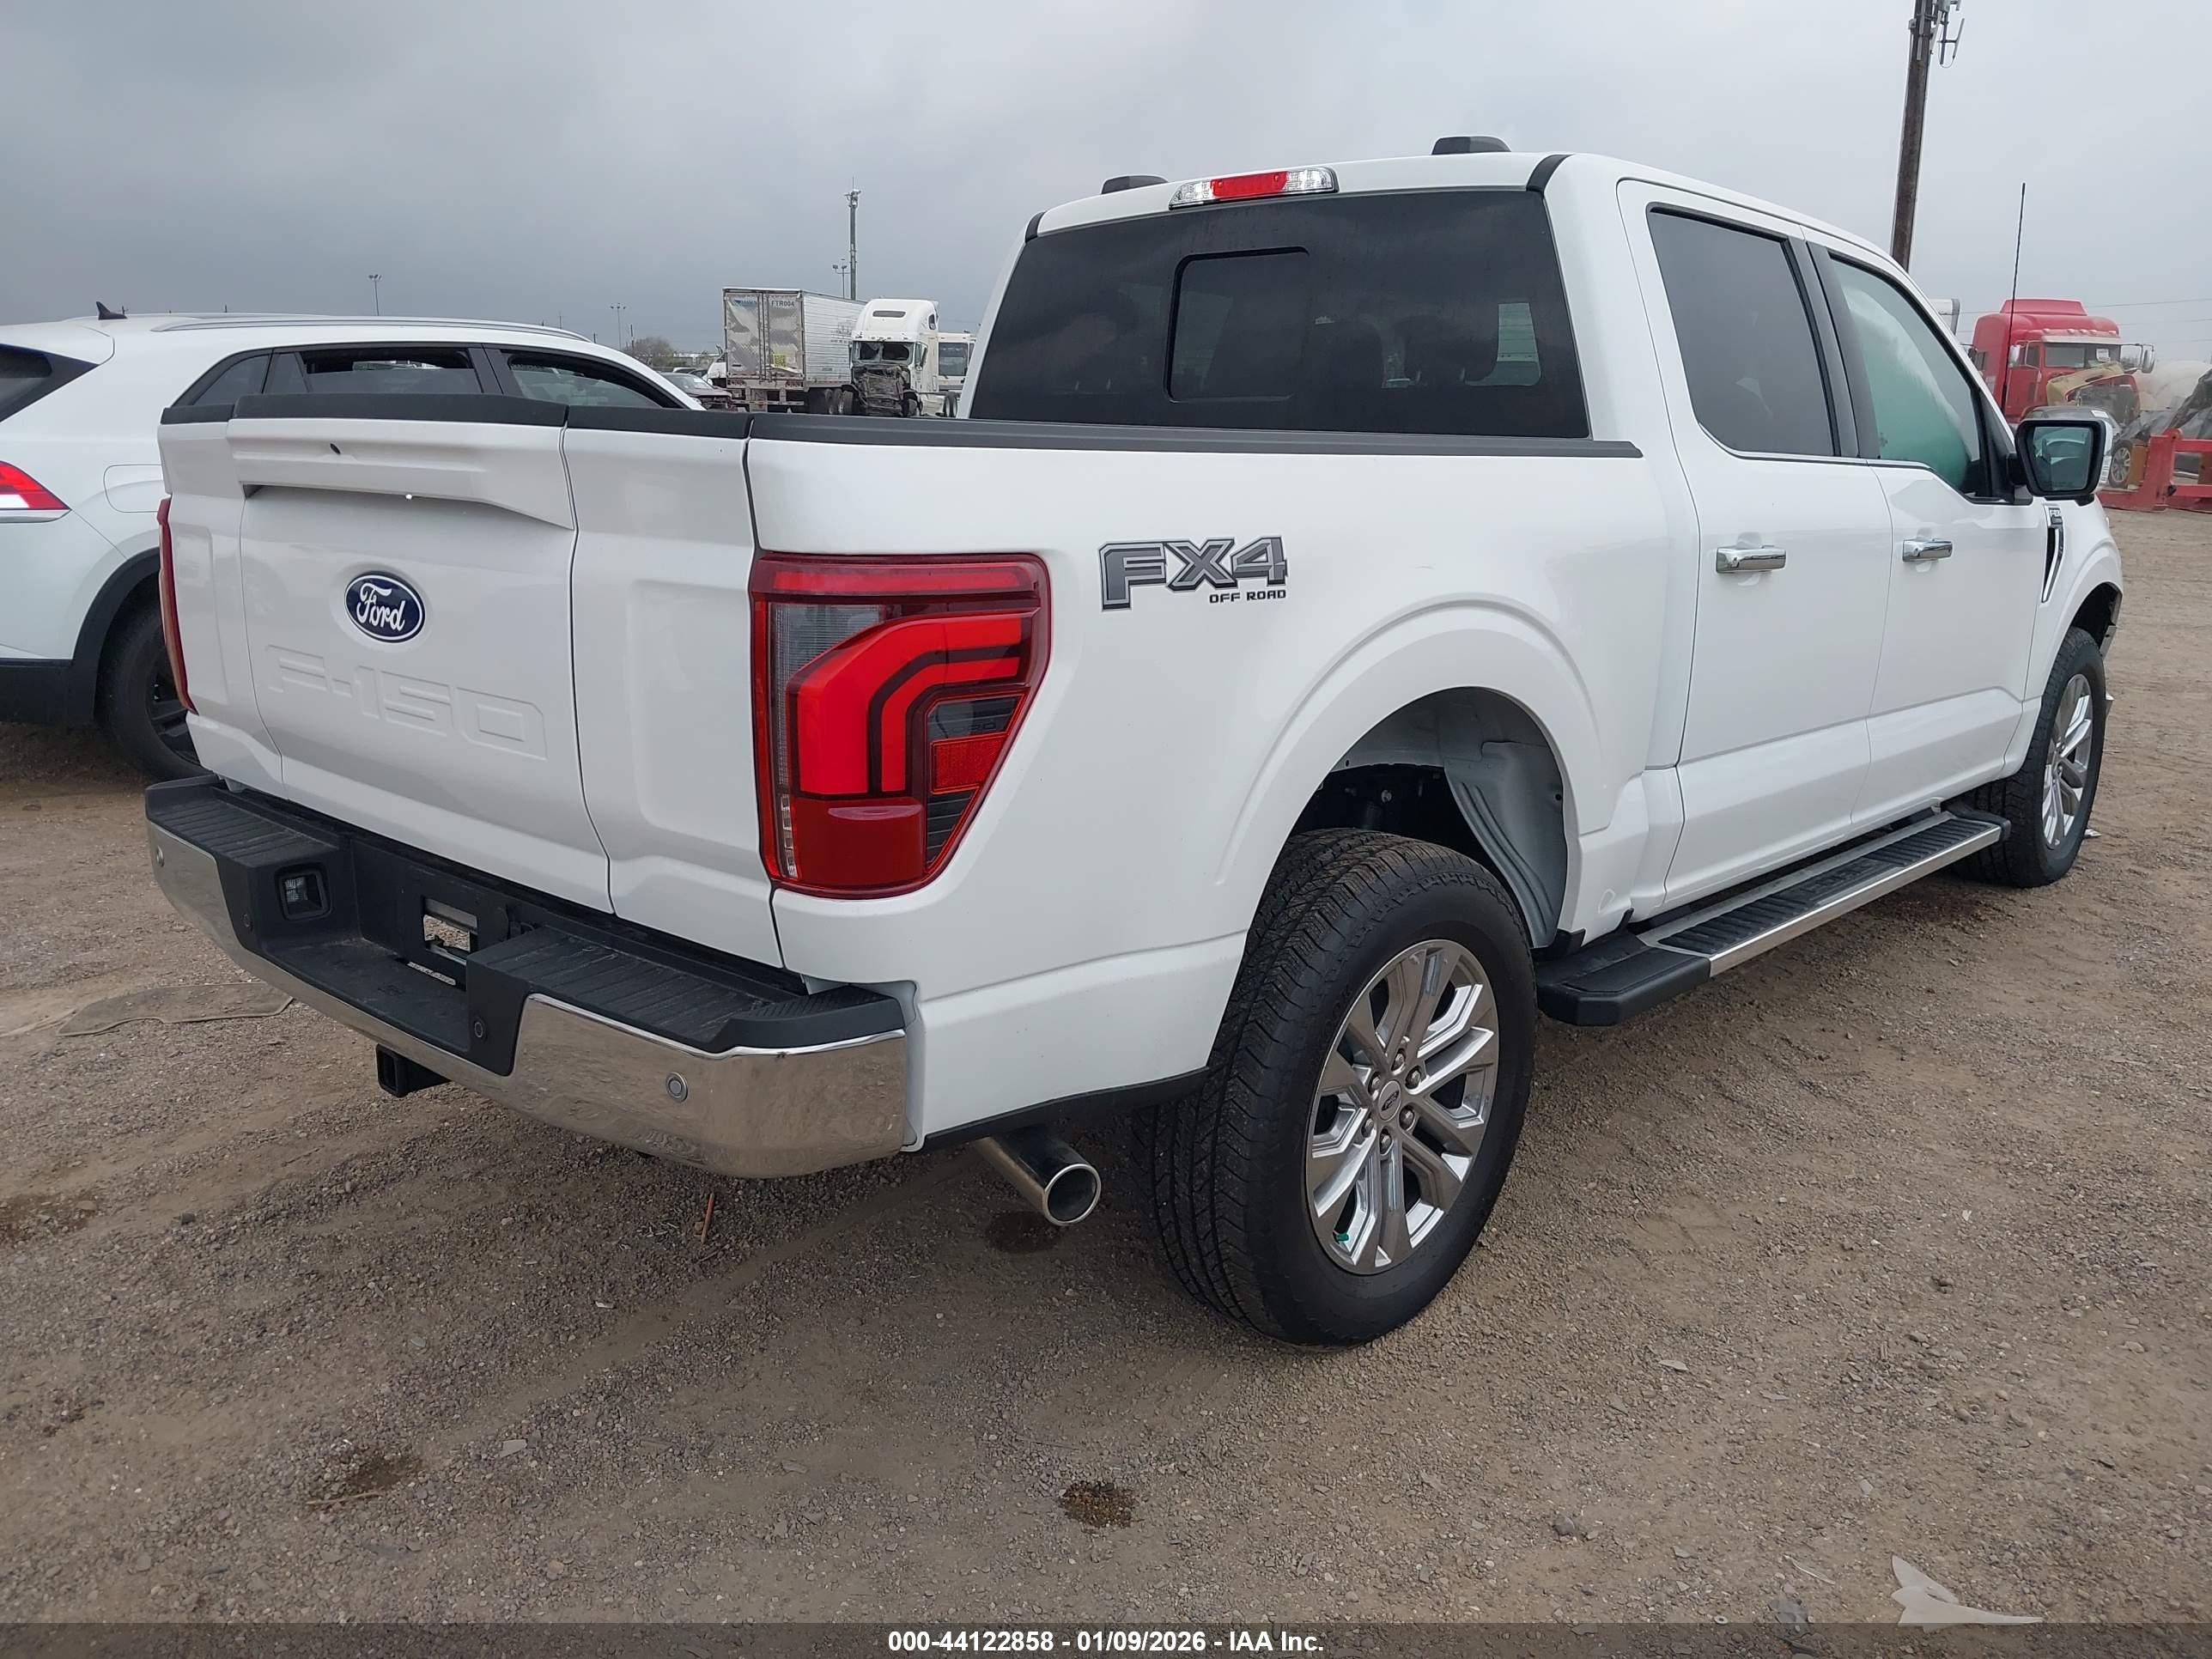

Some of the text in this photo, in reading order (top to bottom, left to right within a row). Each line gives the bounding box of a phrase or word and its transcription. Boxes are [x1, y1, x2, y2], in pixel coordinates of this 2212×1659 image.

[1098, 536, 1288, 611] FX4
[1209, 589, 1286, 604] OFF ROAD
[356, 582, 406, 631] Ford
[264, 644, 549, 761] F-150
